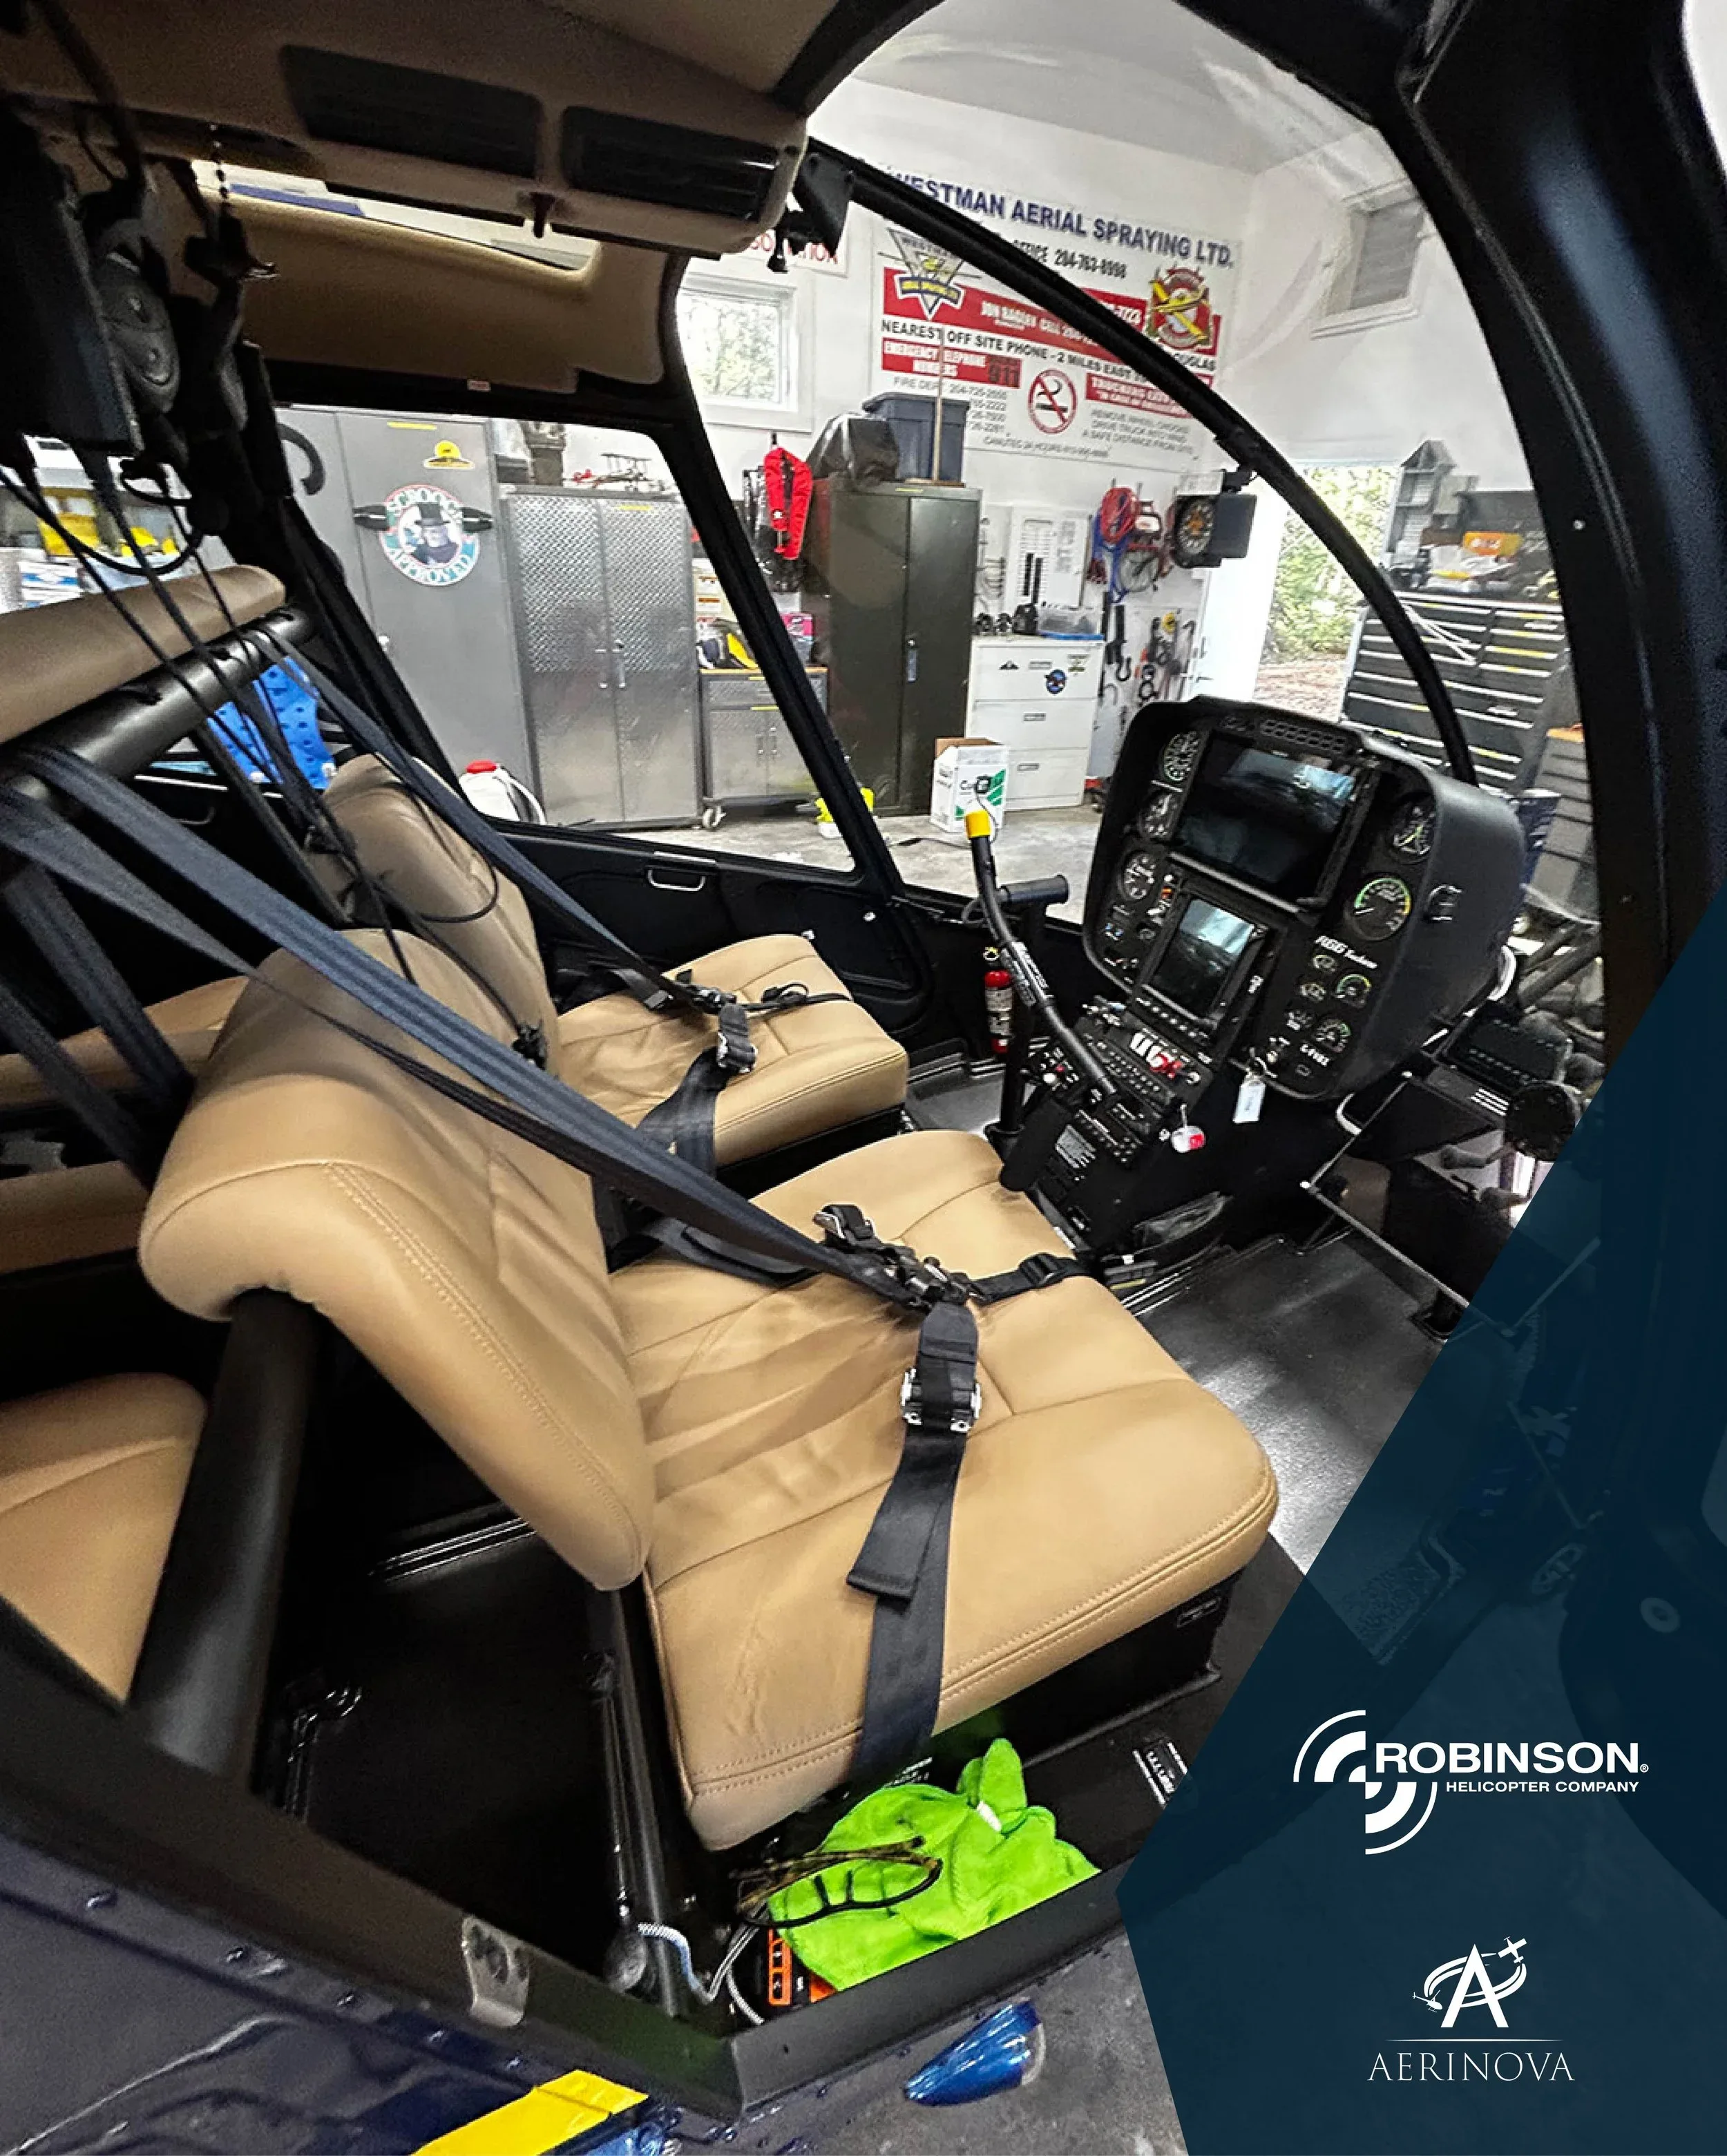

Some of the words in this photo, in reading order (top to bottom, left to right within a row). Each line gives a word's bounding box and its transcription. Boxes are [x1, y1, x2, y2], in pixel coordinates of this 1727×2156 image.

[1011, 199, 1087, 236] AERIAL
[1093, 218, 1191, 260] SPRAYING
[1195, 239, 1233, 269] LTD.
[881, 318, 944, 340] NEAREST
[947, 330, 971, 346] OFF
[975, 334, 1004, 352] SITE
[1006, 341, 1049, 359] PHONE
[1056, 352, 1065, 363] 2
[1067, 354, 1101, 372] MILES
